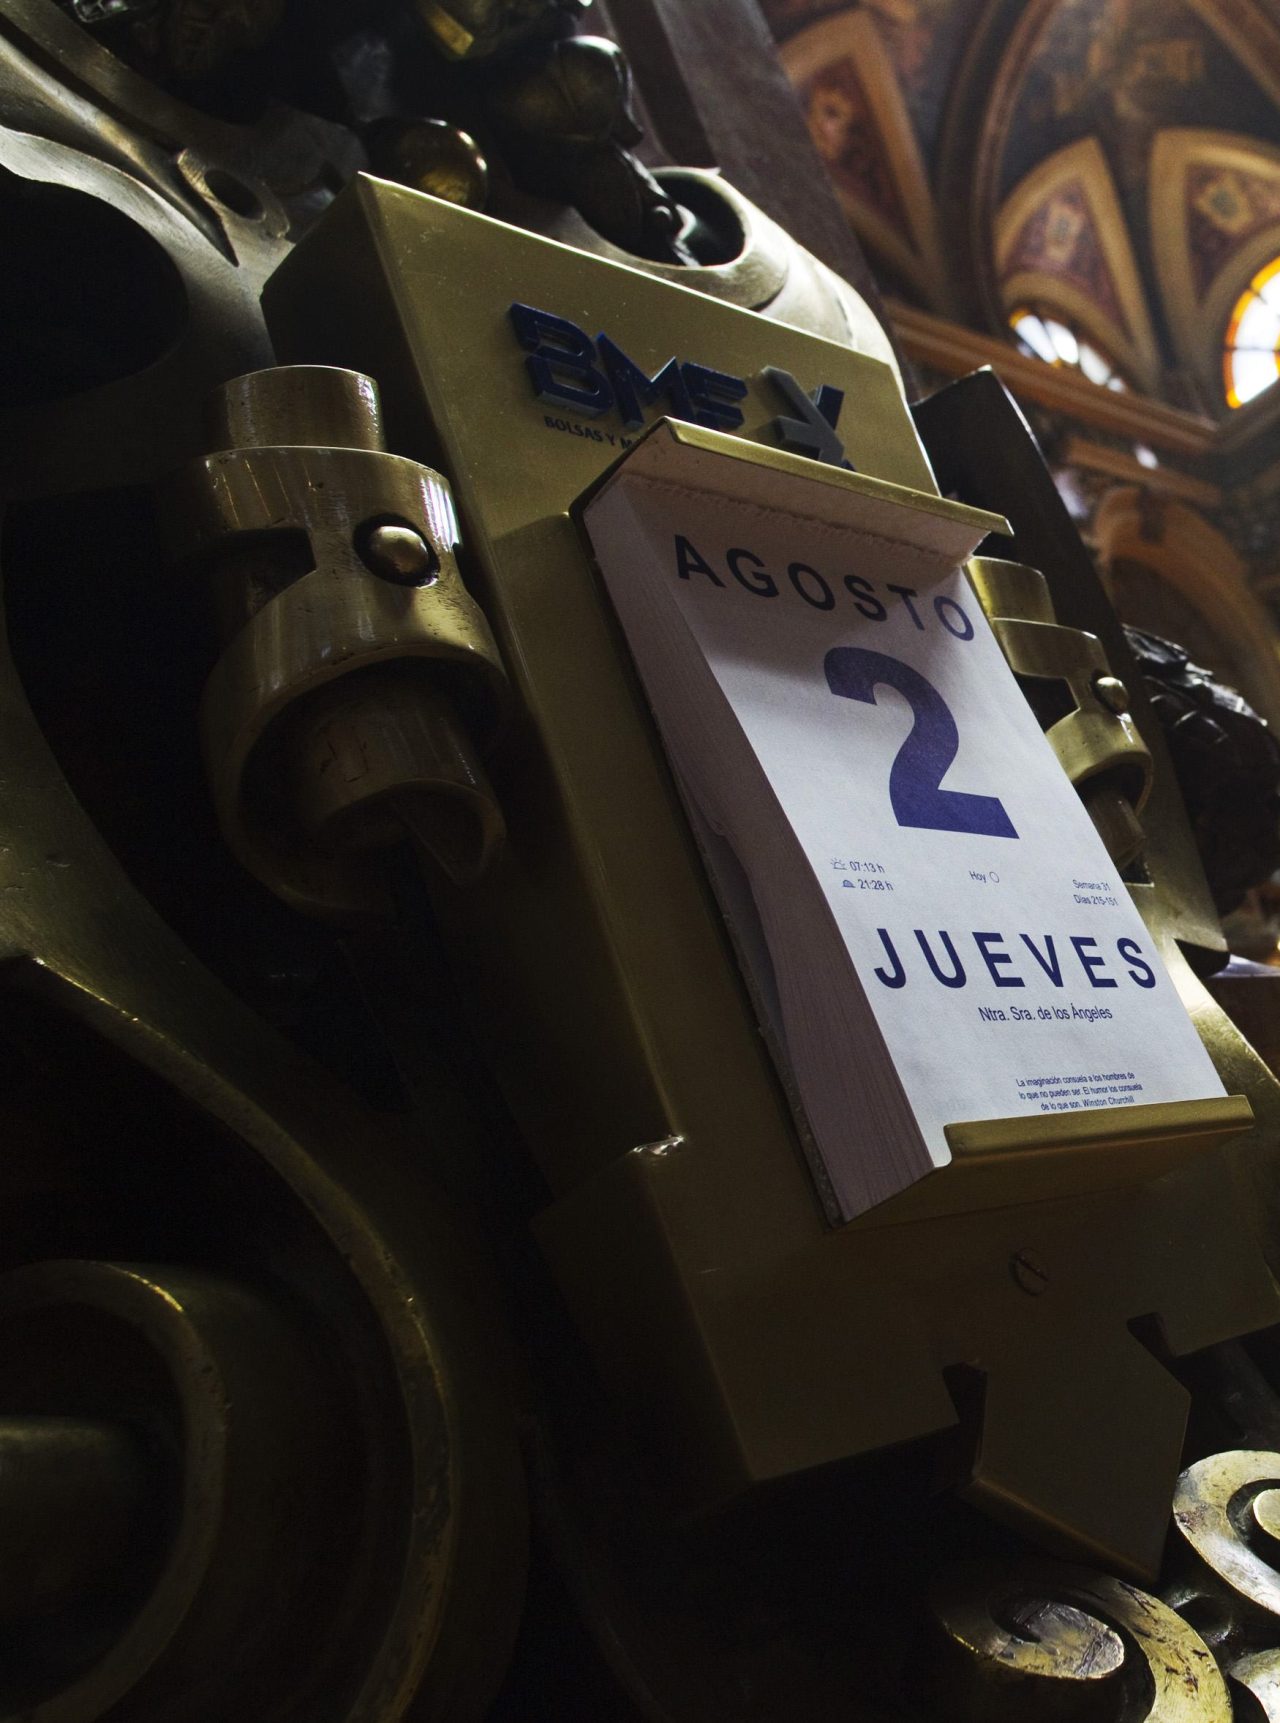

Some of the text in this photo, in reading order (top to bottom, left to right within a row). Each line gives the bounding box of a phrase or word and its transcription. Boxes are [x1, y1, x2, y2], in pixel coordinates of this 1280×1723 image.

[543, 415, 604, 442] BOLSAS
[605, 432, 616, 446] Y
[674, 534, 975, 642] AGOSTO
[824, 646, 1020, 840] 2
[849, 861, 886, 873] 07:13 h
[968, 870, 987, 884] Hoy
[1072, 879, 1102, 891] Semana
[873, 928, 1156, 988] JUEVES
[978, 1003, 1113, 1022] Ntra. Sra. de los Ángeles
[1015, 1078, 1026, 1087] La
[1092, 1074, 1103, 1082] los
[1102, 1072, 1127, 1081] hombres
[1127, 1072, 1135, 1080] de
[1018, 1091, 1026, 1100] lo
[1026, 1091, 1039, 1101] que
[1039, 1091, 1049, 1099] no
[1049, 1088, 1071, 1099] pueden
[1082, 1086, 1091, 1095] El
[1040, 1102, 1050, 1111] de
[1049, 1102, 1057, 1110] lo
[1056, 1102, 1069, 1111] que
